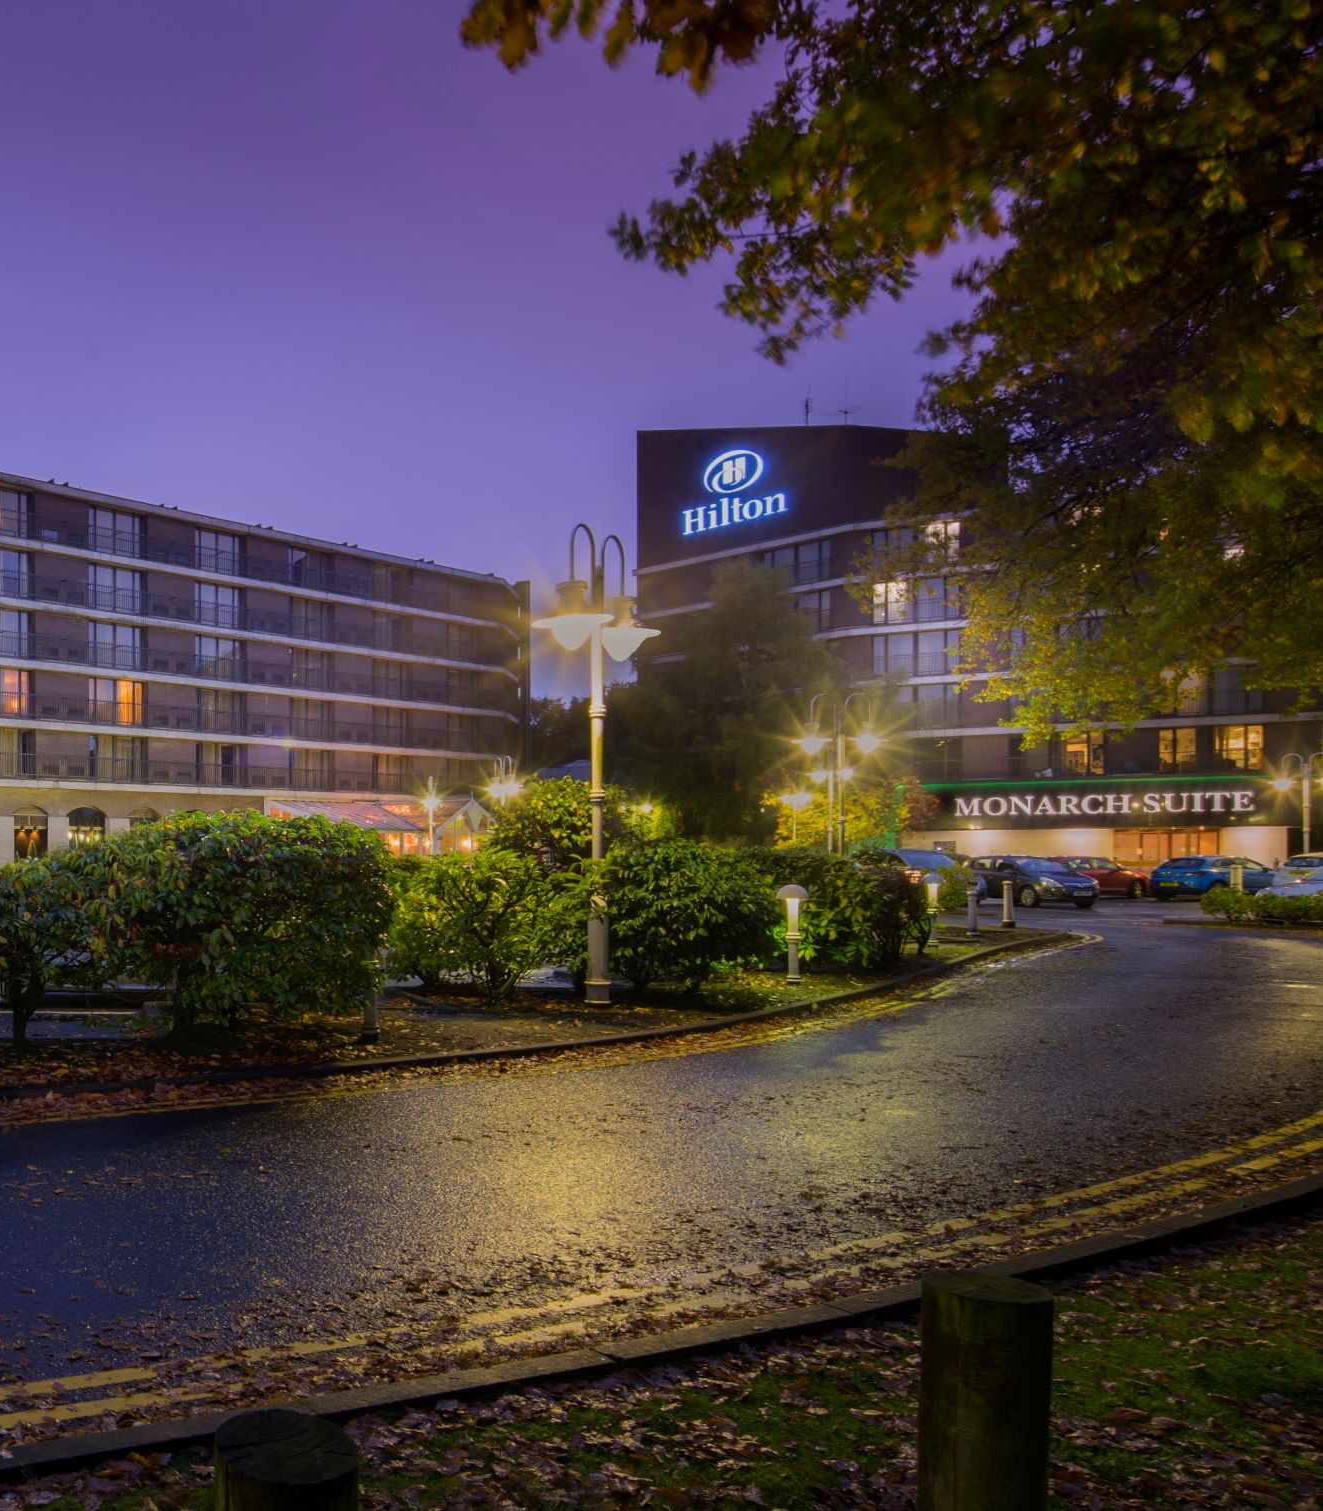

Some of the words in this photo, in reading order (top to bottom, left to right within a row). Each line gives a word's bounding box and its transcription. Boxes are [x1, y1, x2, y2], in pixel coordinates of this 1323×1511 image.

[682, 492, 788, 536] Hilton
[954, 793, 1132, 816] MONARCH
[1143, 791, 1256, 813] SUITE
